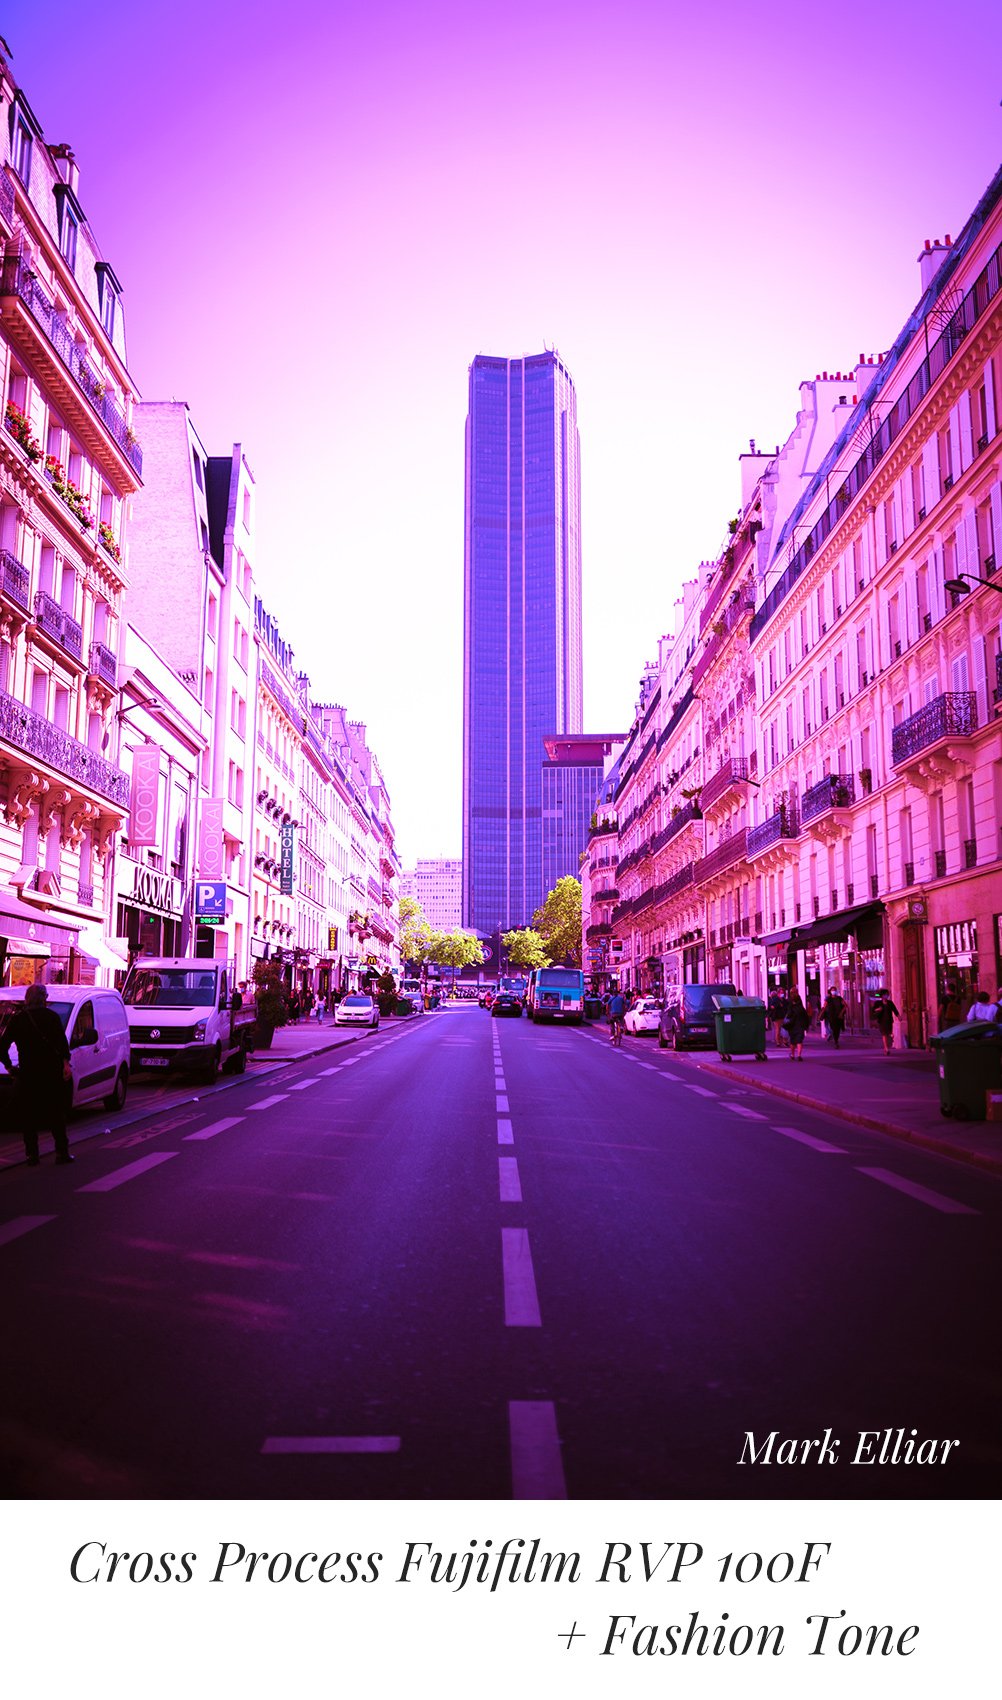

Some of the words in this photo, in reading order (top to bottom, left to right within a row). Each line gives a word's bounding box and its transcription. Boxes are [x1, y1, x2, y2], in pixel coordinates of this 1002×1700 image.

[134, 751, 157, 841] KOOKAI
[203, 802, 220, 875] KOOKAI
[282, 827, 293, 878] HOTEL
[199, 885, 215, 906] P
